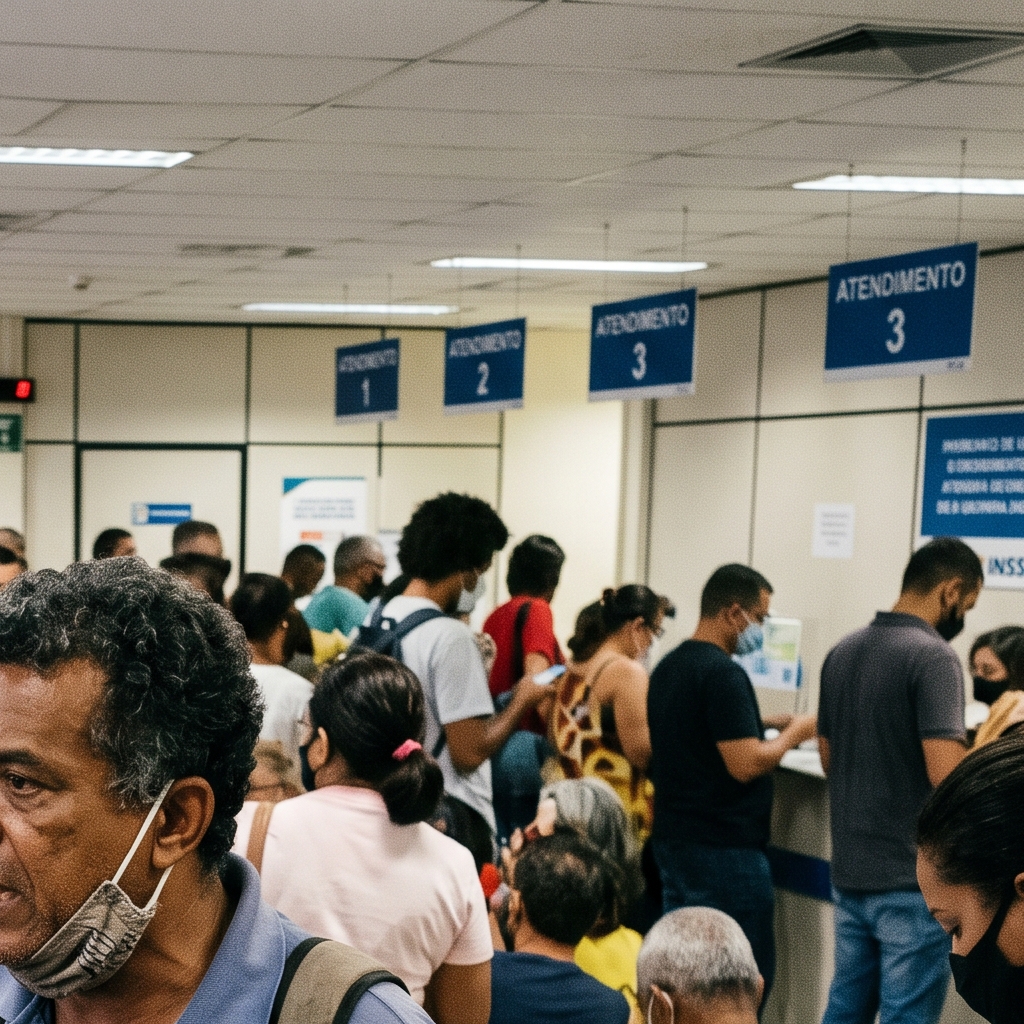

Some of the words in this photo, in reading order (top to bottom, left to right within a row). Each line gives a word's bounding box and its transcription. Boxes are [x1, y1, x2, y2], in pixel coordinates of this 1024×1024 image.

[836, 260, 966, 304] ATENDIMENTO
[595, 303, 690, 338] ATENDIMENTO
[885, 307, 906, 355] 3
[476, 361, 490, 396] 2
[631, 341, 647, 381] 3
[361, 377, 370, 407] 1
